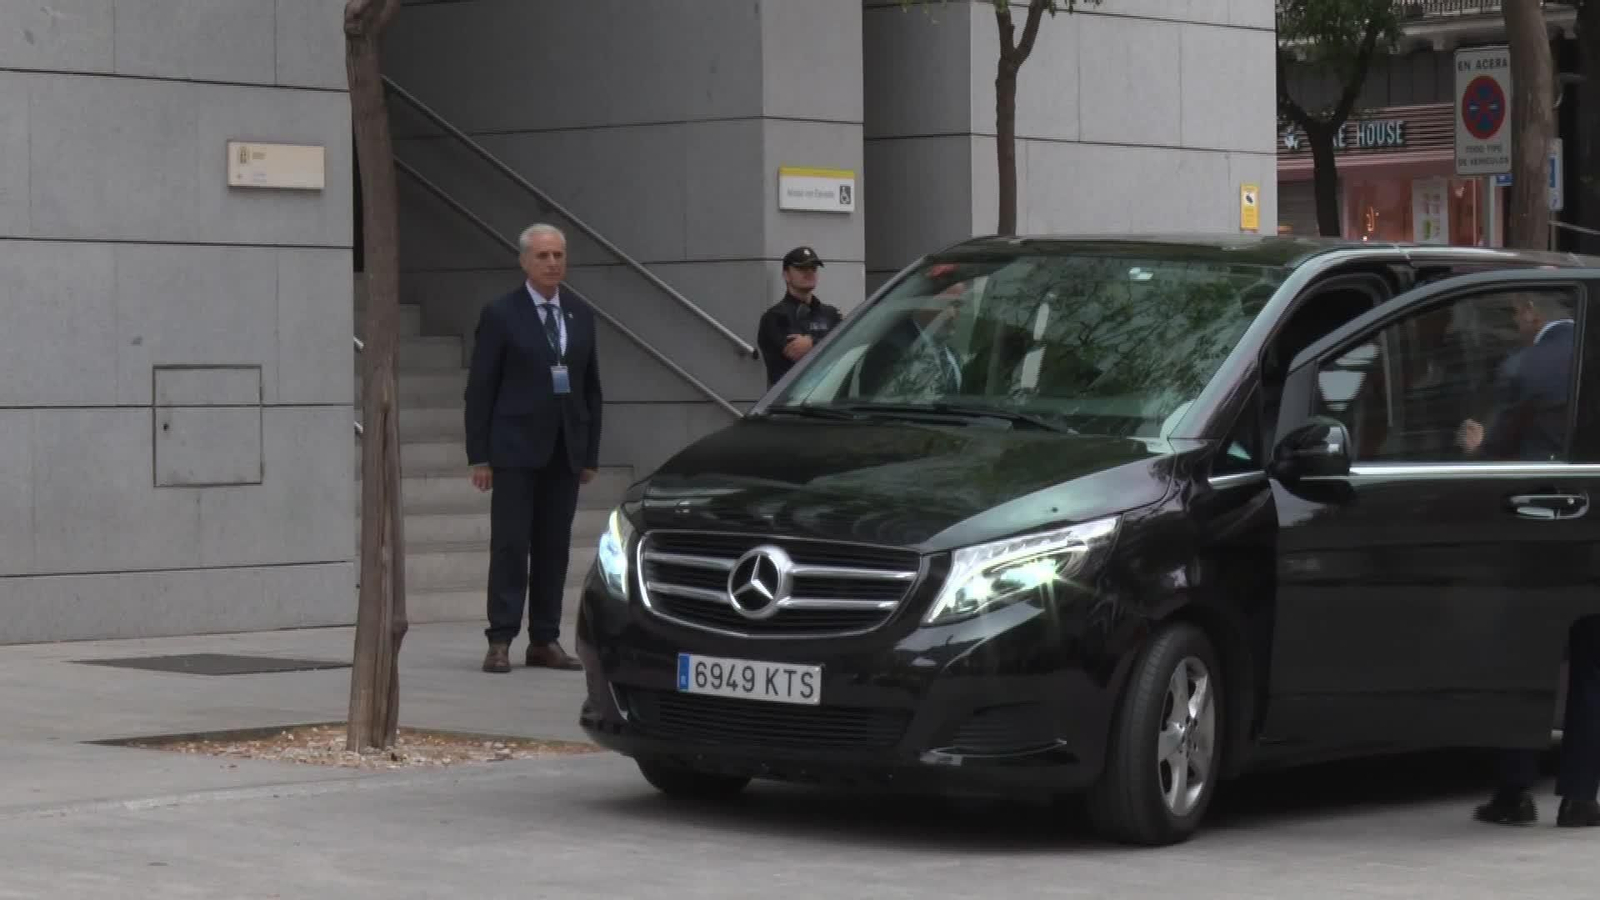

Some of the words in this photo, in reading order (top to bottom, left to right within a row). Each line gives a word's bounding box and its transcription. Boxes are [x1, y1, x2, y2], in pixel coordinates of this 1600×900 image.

[1458, 60, 1471, 71] EN
[1476, 58, 1507, 69] ACERA
[1356, 120, 1404, 146] HOUSE
[695, 661, 755, 693] 6949
[766, 667, 814, 699] KTS
